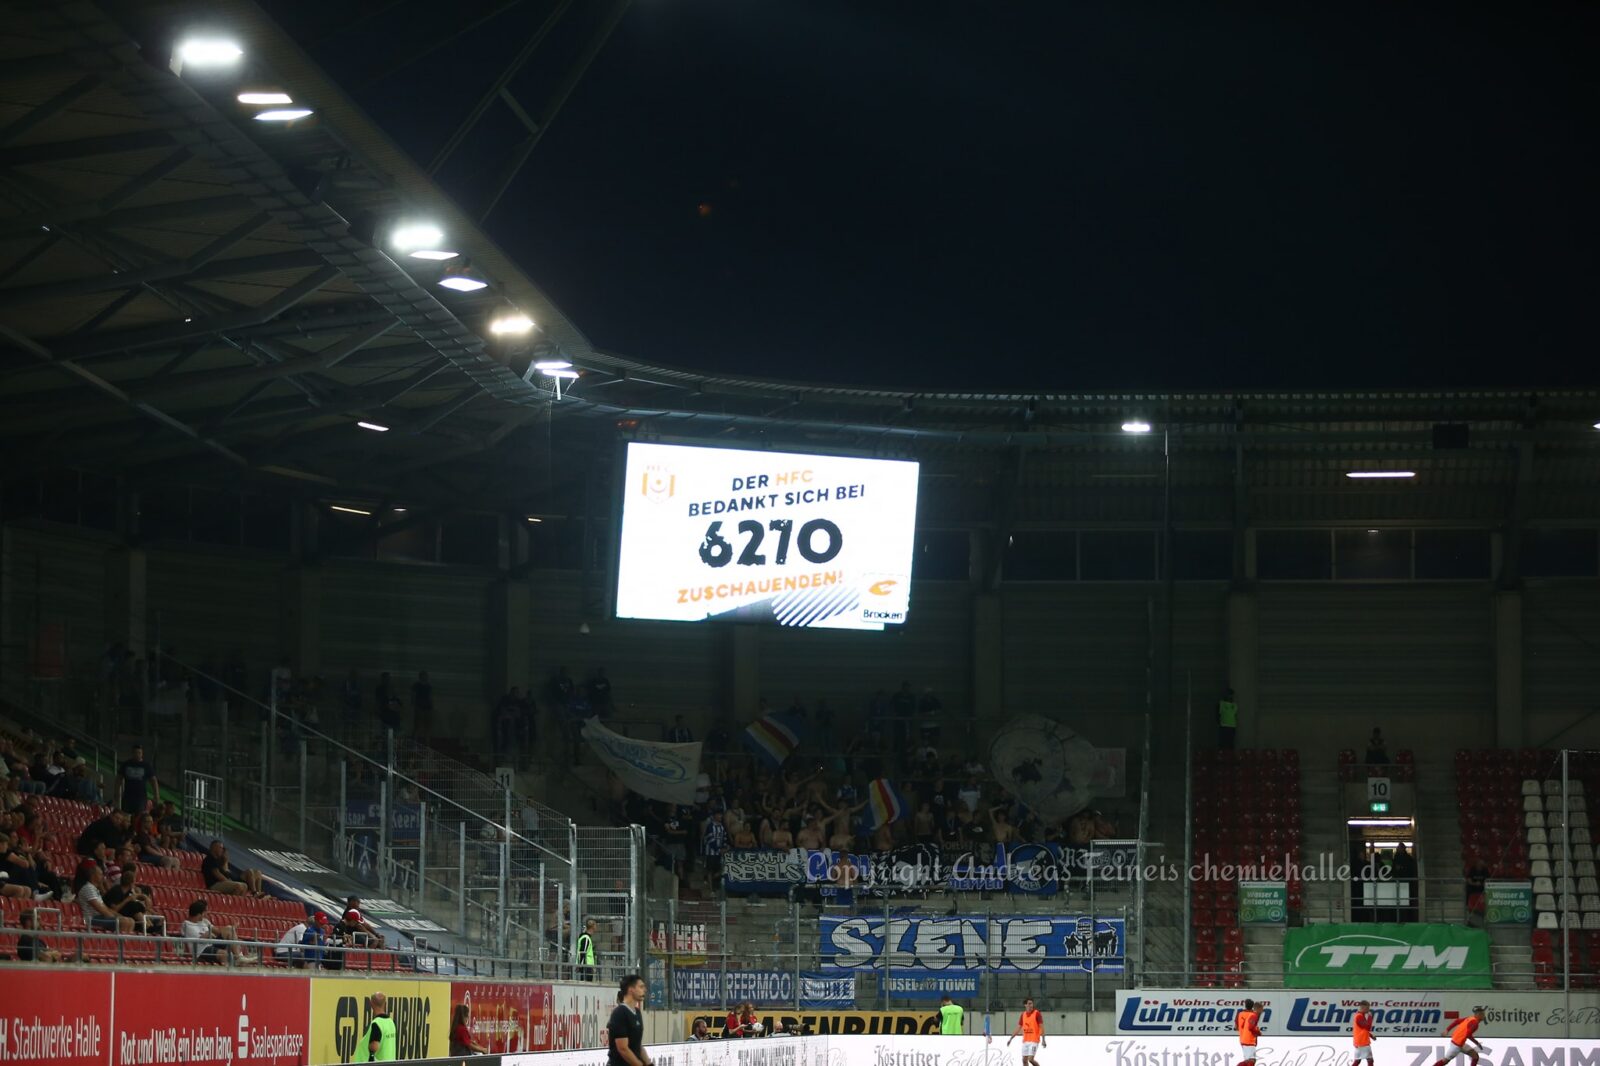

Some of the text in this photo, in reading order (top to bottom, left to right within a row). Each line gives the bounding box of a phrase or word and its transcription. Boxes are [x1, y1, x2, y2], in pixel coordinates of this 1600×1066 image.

[732, 470, 814, 491] DER HFC
[688, 484, 866, 517] BEDANKT SICH BEI
[677, 570, 843, 604] ZUSCHAUENDEN!
[863, 608, 903, 621] Brocken
[1371, 783, 1387, 796] 10
[1243, 898, 1284, 906] Entsorgung
[1488, 899, 1529, 908] Entsorgung
[1320, 945, 1469, 970] TTM
[938, 977, 976, 992] TOWN
[1119, 996, 1272, 1031] Lührman
[1172, 999, 1271, 1007] Wohn-Centm
[1341, 999, 1440, 1008] Won-Centrum
[12, 1015, 73, 1060] Stadtwerke
[75, 1014, 101, 1058] Halle
[121, 1030, 136, 1066] Rot
[138, 1028, 153, 1063] und
[156, 1027, 176, 1063] Weiß
[178, 1027, 190, 1062] ein
[191, 1027, 214, 1062] Leben
[251, 1026, 303, 1065] Saalesparkasse
[1105, 1040, 1235, 1066] Köstritzer
